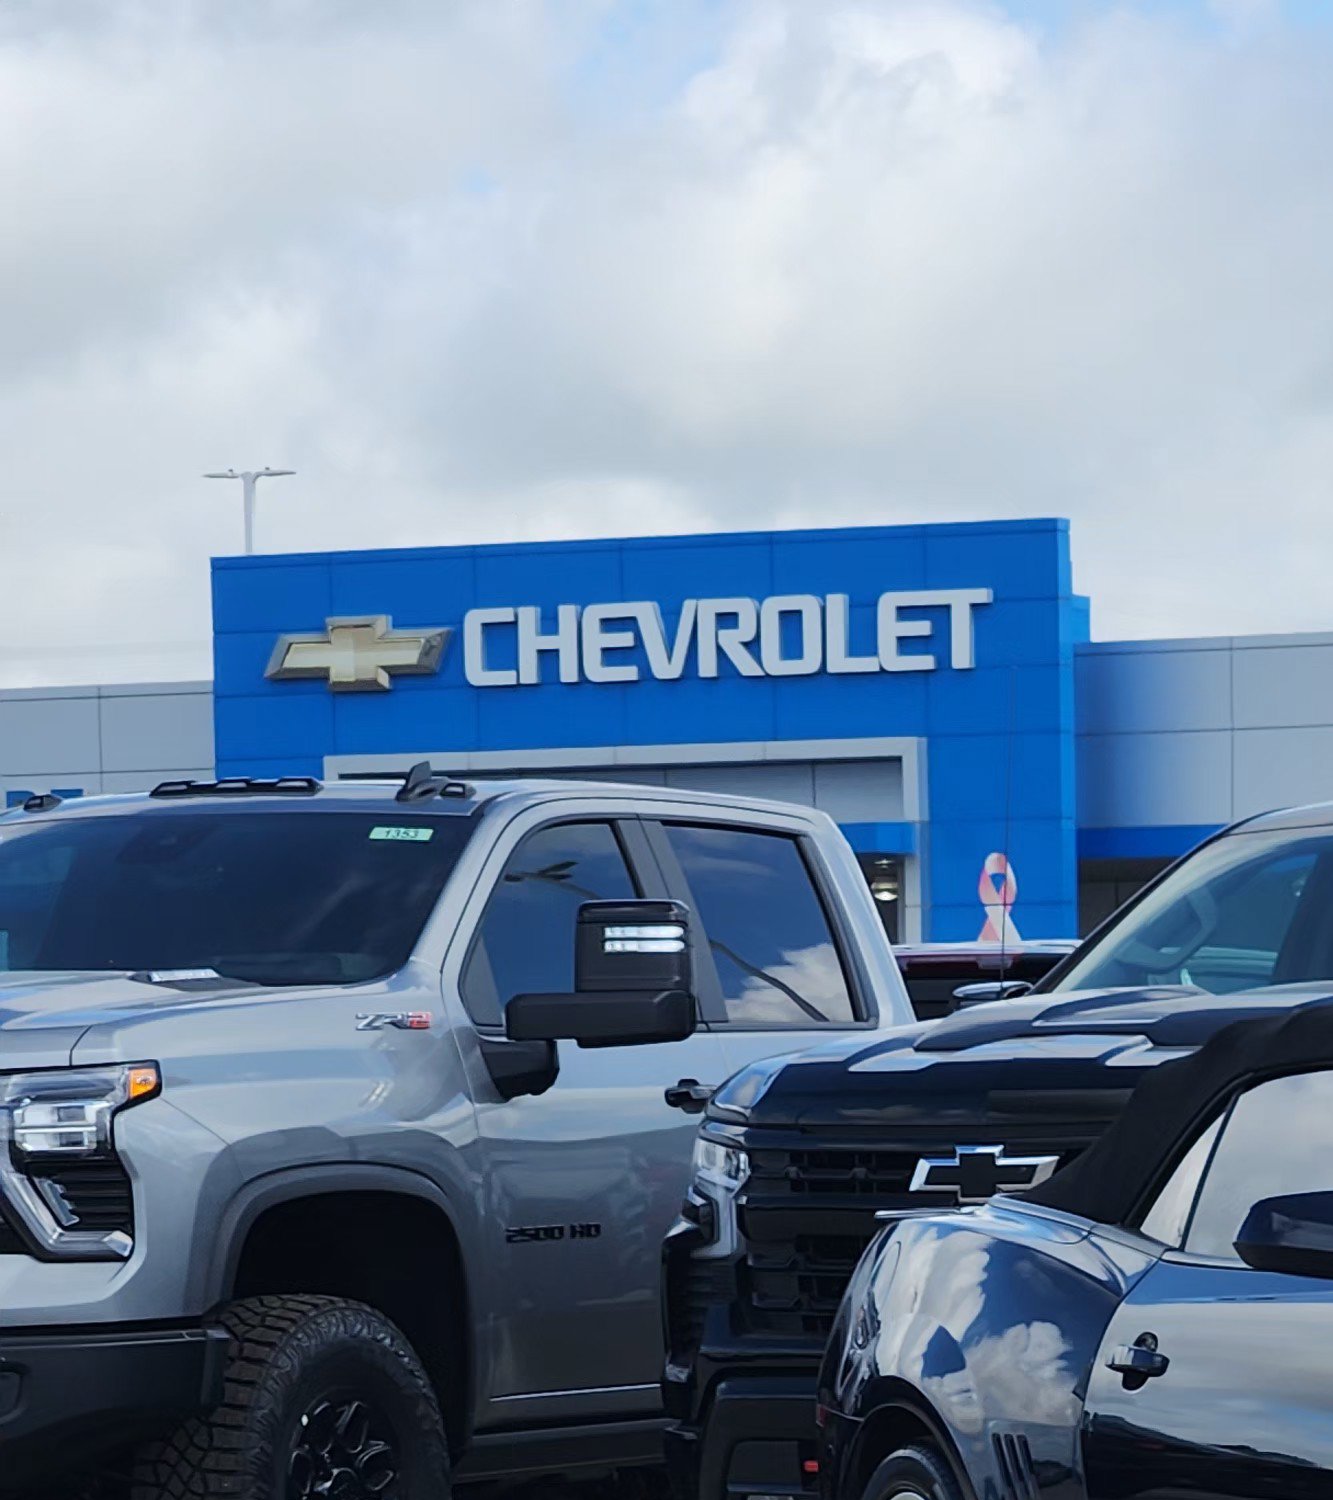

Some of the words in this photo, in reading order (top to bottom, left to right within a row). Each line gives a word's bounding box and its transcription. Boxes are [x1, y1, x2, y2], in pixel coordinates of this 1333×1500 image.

[464, 588, 993, 686] CHEVROLET
[355, 1011, 432, 1031] ZR2
[506, 1226, 564, 1242] 2500
[570, 1222, 601, 1239] HD
